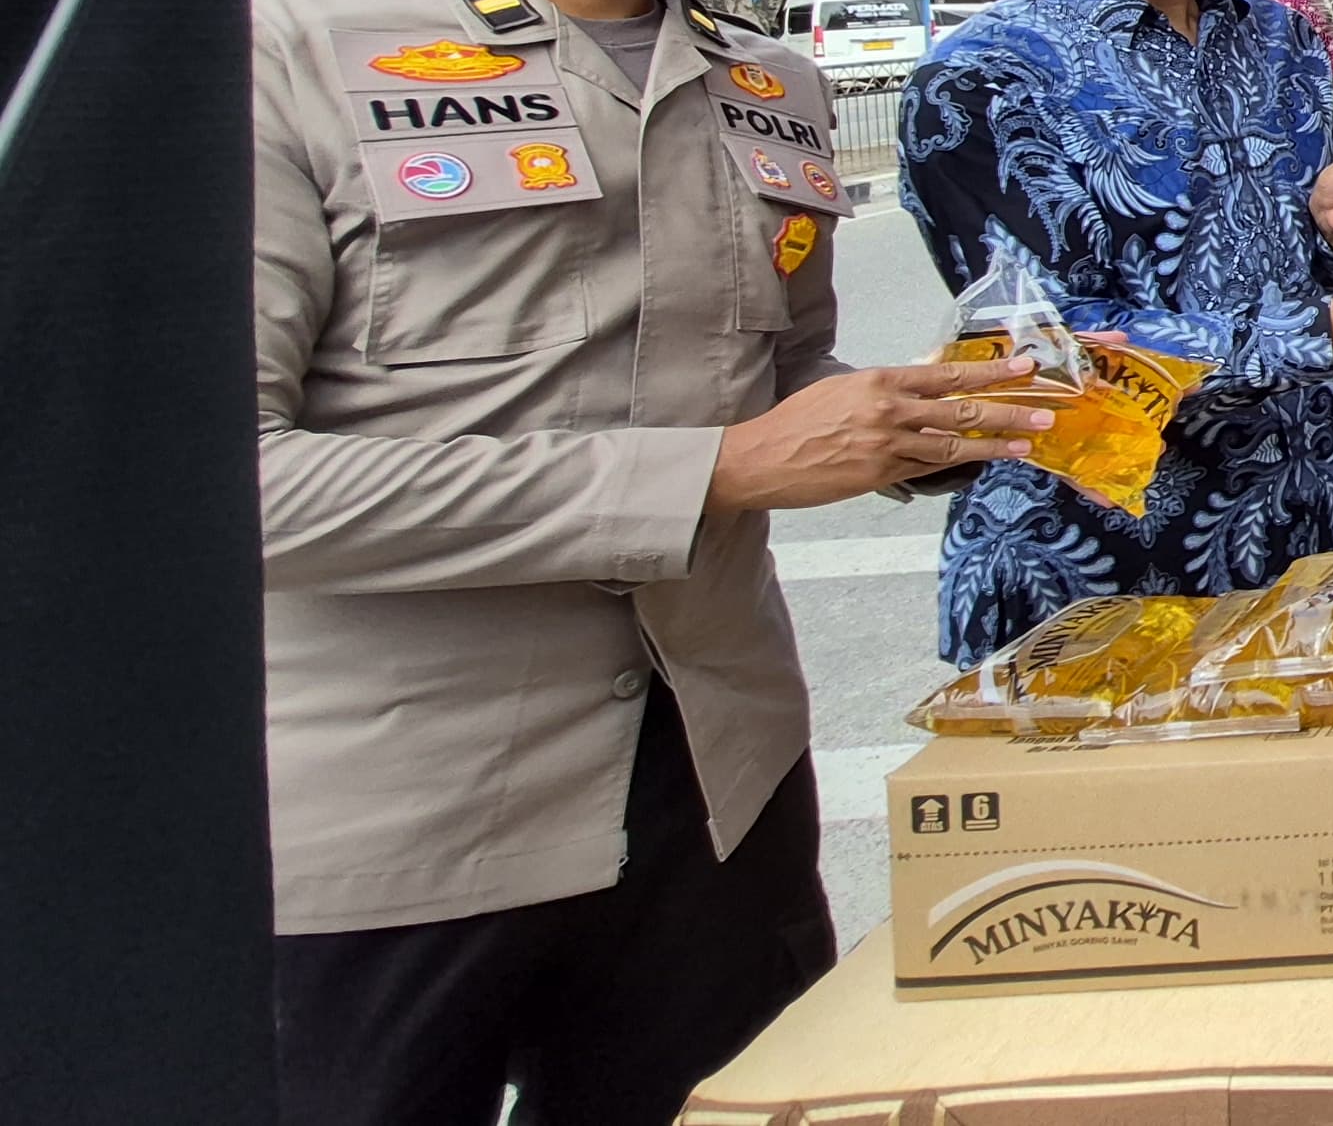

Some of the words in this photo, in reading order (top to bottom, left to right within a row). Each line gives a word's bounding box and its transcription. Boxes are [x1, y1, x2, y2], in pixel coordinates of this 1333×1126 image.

[369, 92, 561, 131] HANS
[719, 101, 824, 151] POLRI
[972, 795, 990, 820] 6
[1319, 872, 1325, 885] 1
[1320, 905, 1333, 913] PT
[963, 899, 1201, 966] MINYAKITA
